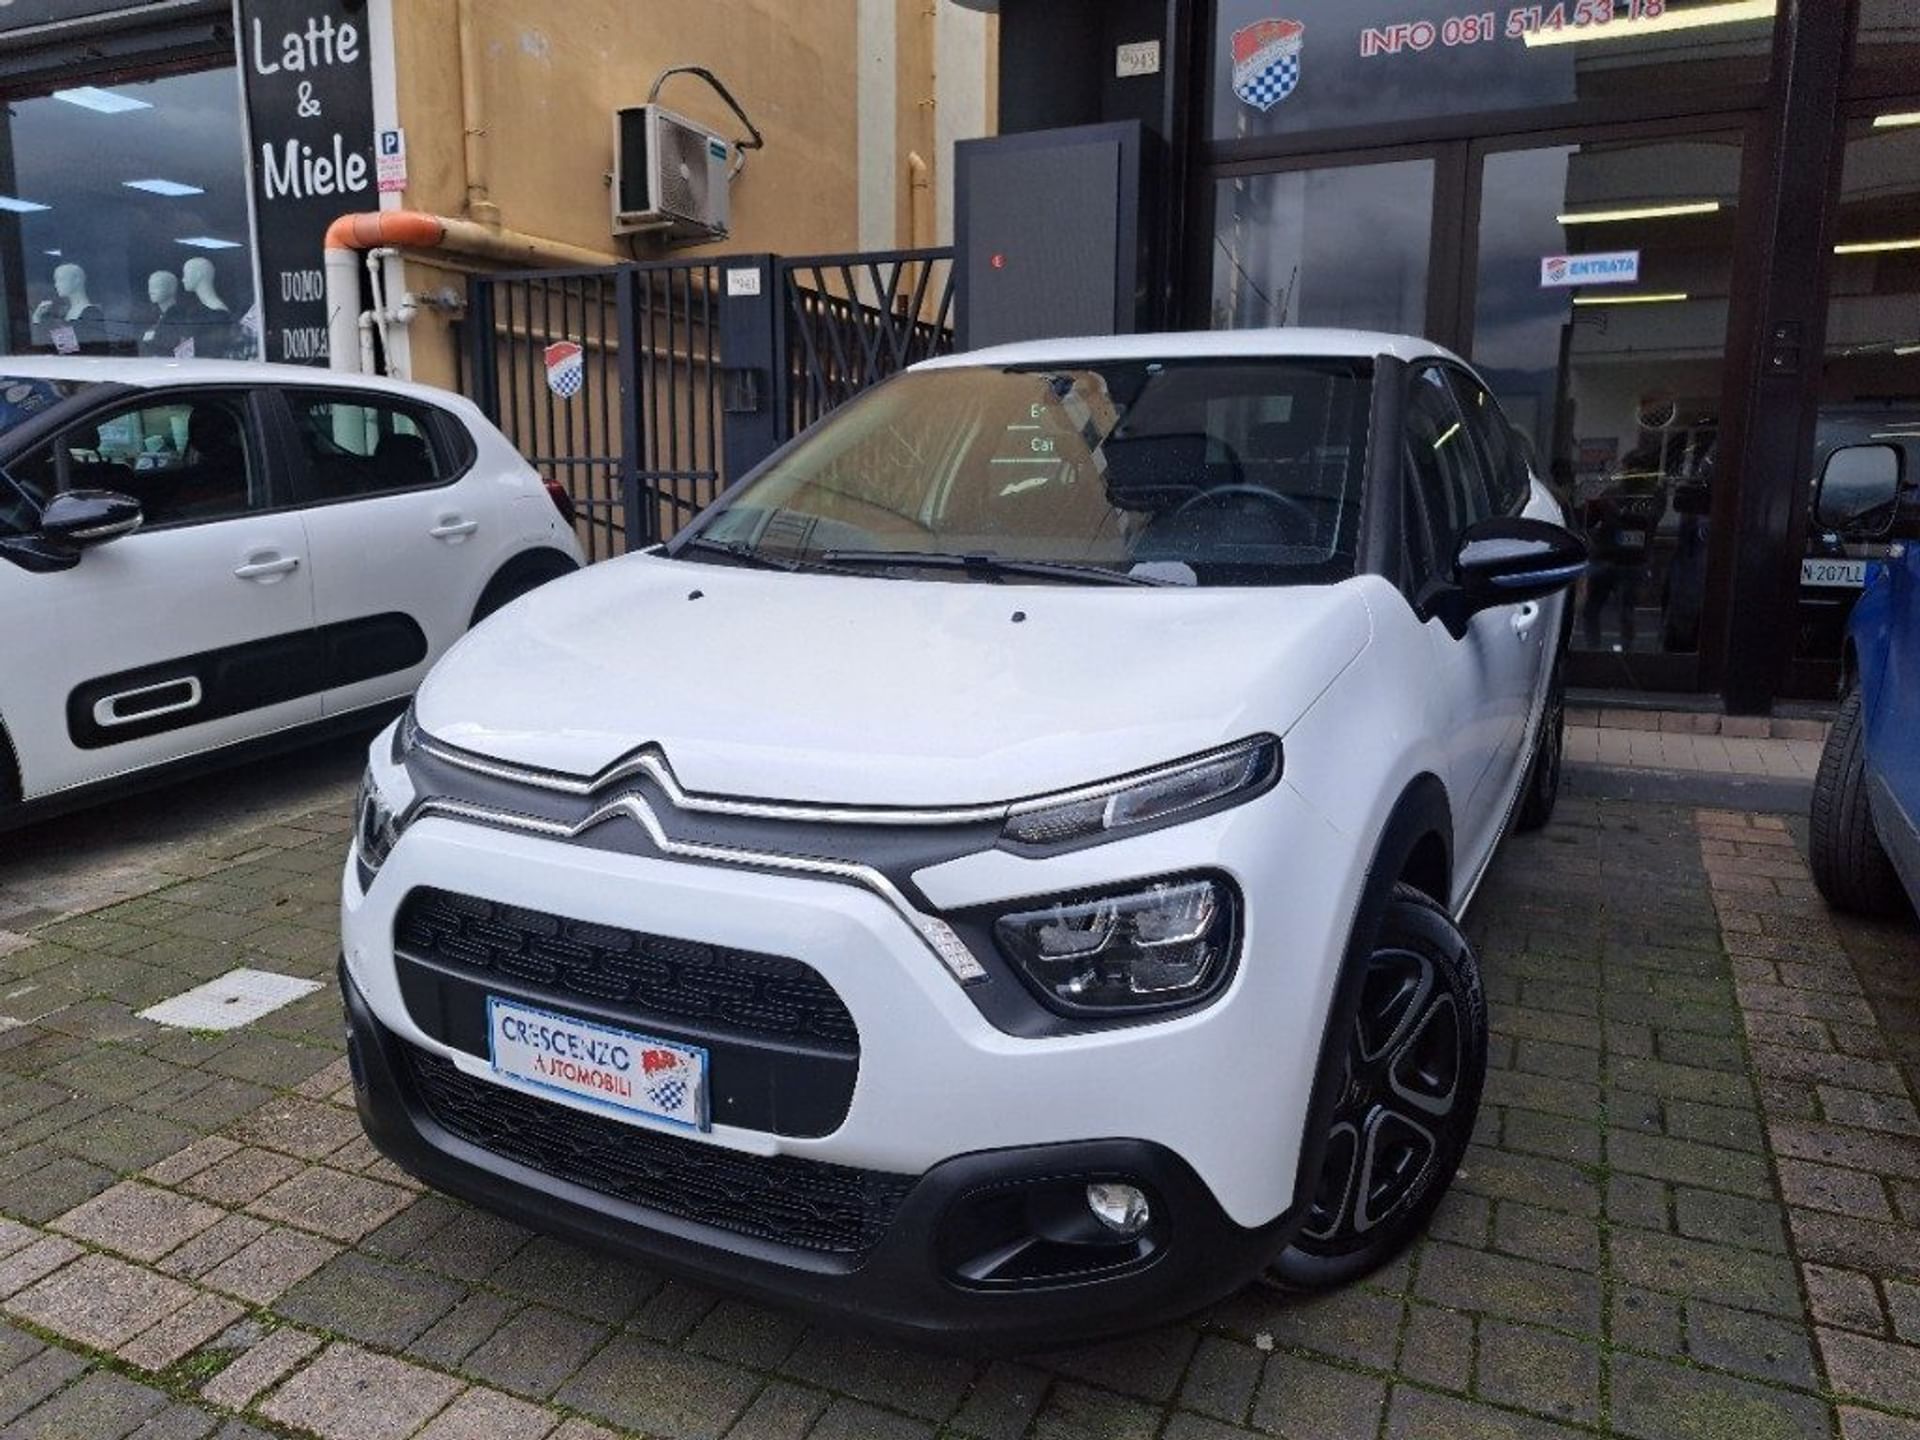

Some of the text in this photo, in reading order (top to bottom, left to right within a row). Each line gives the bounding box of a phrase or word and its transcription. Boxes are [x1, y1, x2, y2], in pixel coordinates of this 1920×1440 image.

[253, 14, 360, 75] Latte
[1360, 21, 1435, 57] INFO
[1441, 12, 1496, 46] 081
[1505, 2, 1567, 38] 514
[1573, 0, 1615, 29] 53
[297, 80, 322, 118] &
[262, 132, 369, 200] Miele
[385, 134, 397, 153] P
[280, 269, 324, 302] UOMO
[1569, 258, 1634, 275] ENTRATA
[501, 1016, 630, 1072] CRESCENZO
